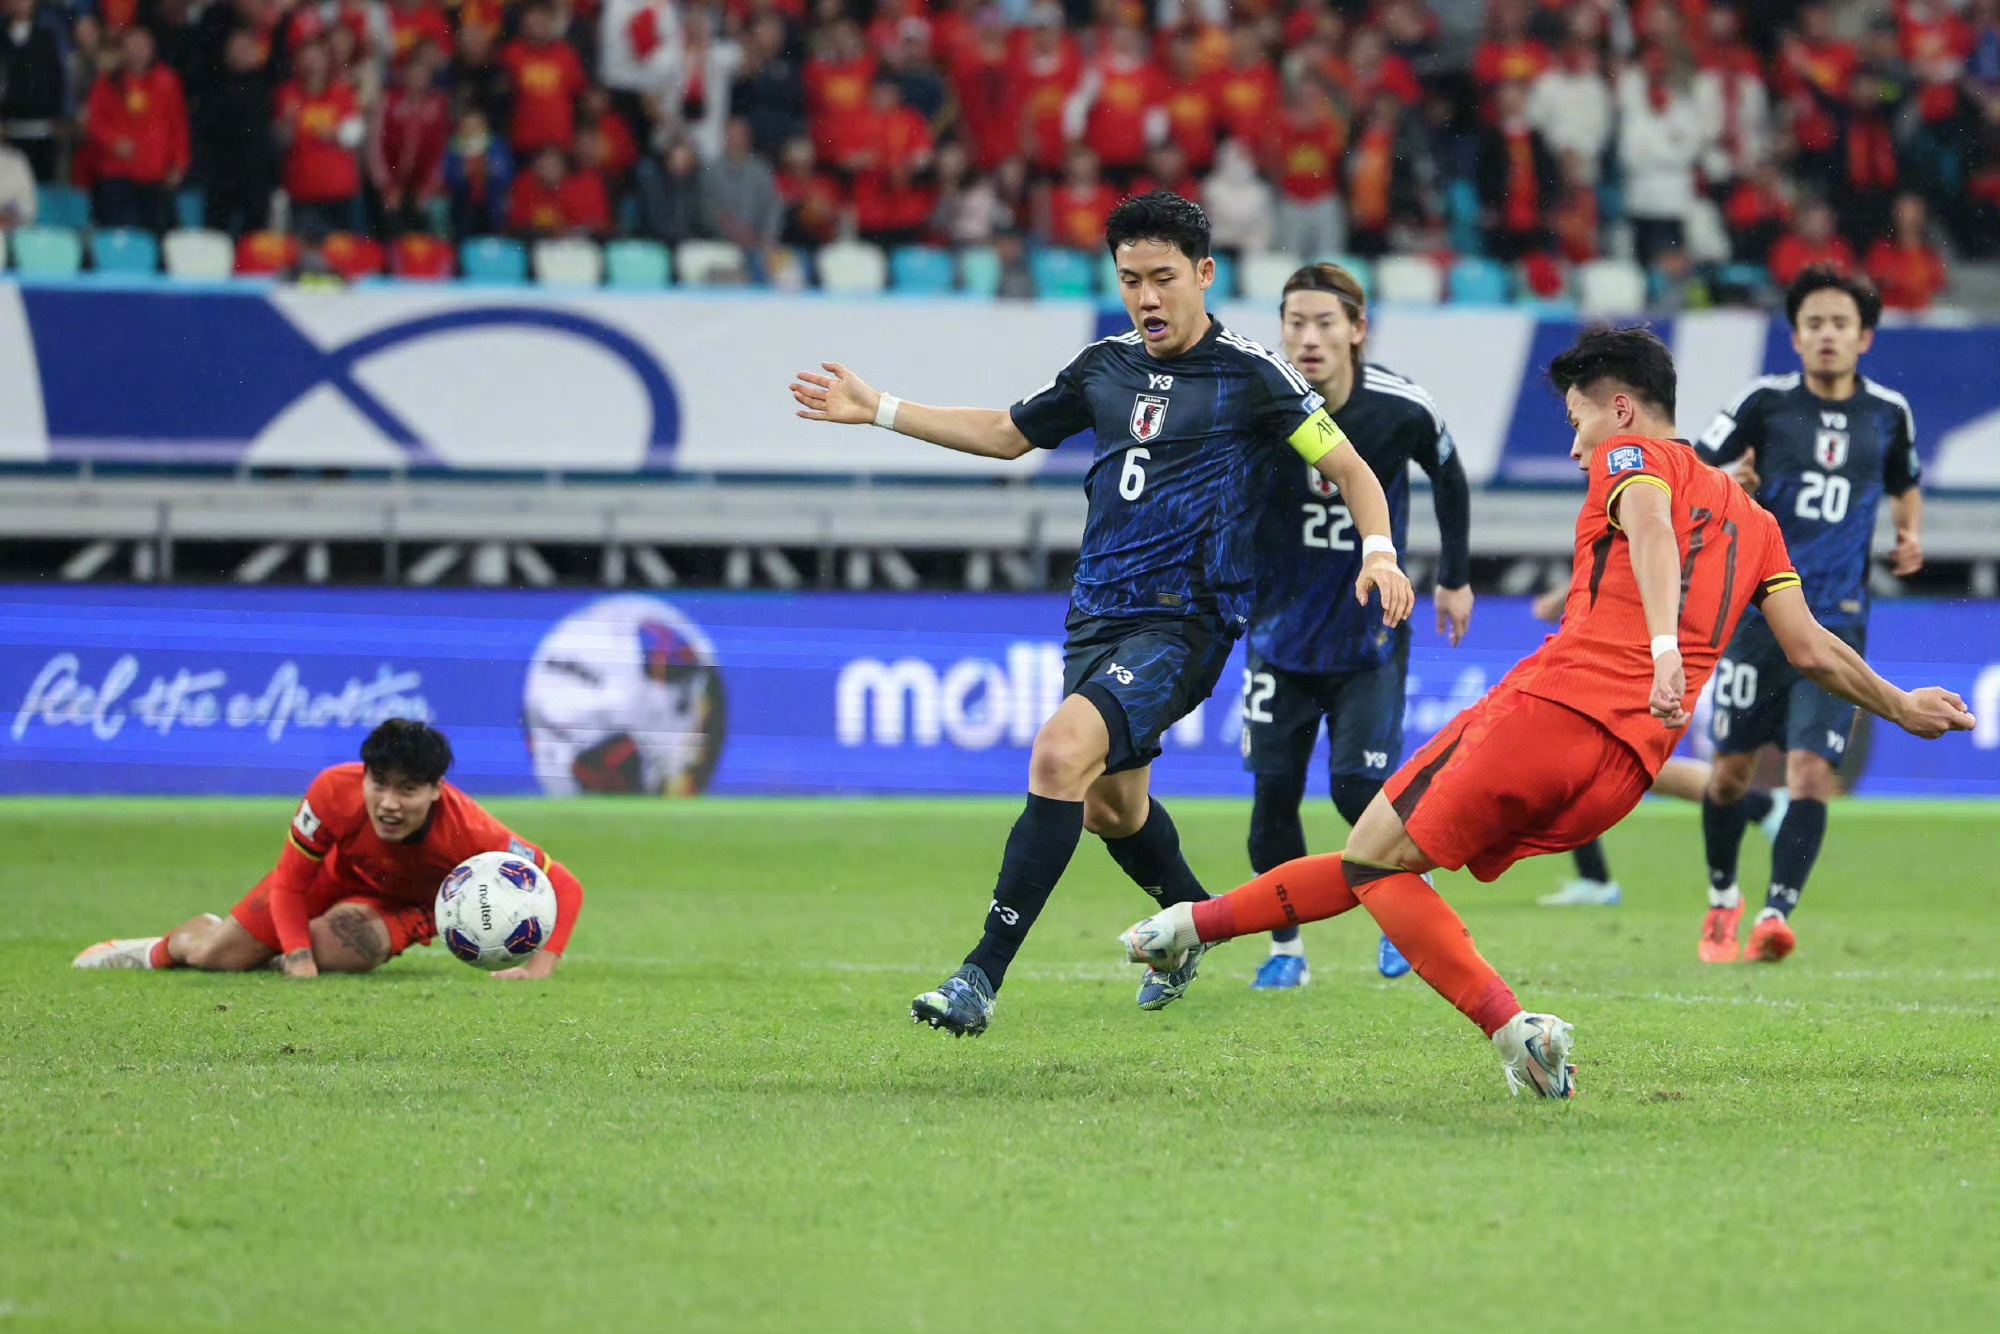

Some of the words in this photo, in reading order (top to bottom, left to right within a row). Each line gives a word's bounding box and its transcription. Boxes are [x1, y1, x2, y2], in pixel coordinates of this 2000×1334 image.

[1148, 373, 1174, 391] Y-3
[1118, 447, 1152, 502] 6
[1794, 470, 1852, 525] 20
[1301, 502, 1356, 551] 22
[1106, 662, 1134, 685] Y-3
[1714, 657, 1759, 710] 20
[479, 884, 492, 931] molten
